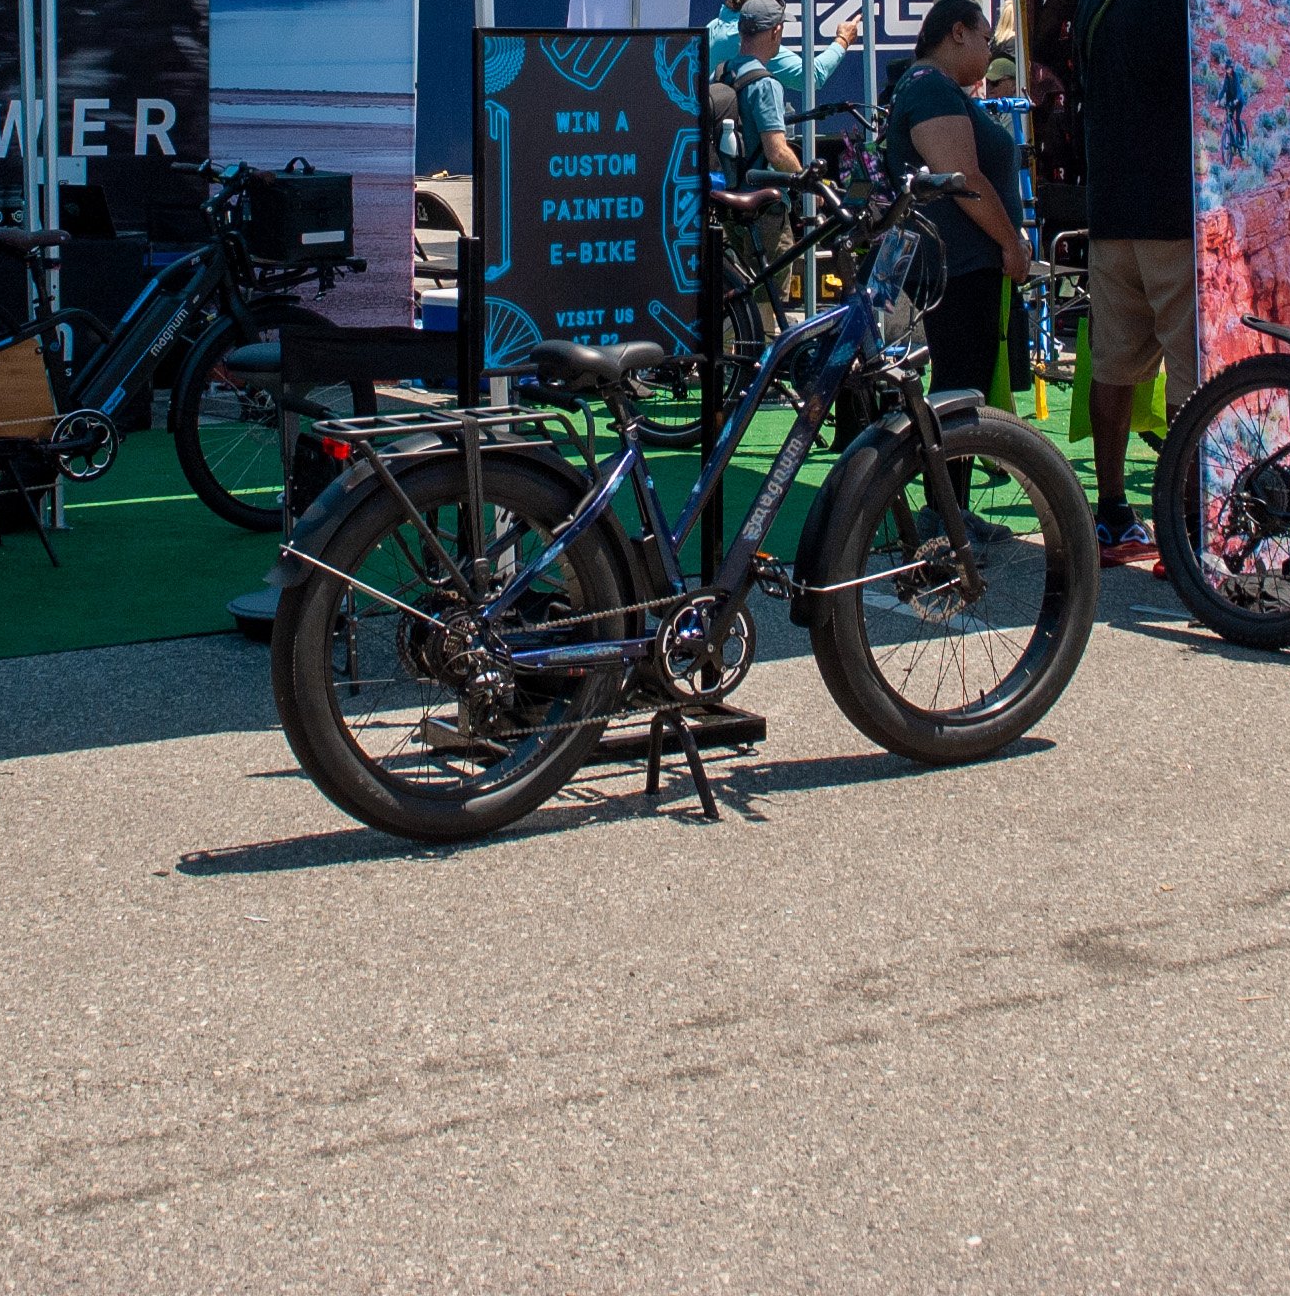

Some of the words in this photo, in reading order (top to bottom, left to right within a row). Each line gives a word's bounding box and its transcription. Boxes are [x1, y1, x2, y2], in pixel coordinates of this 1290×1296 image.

[556, 111, 600, 133] WIN
[615, 111, 629, 132] A
[549, 154, 637, 177] CUSTOM
[542, 196, 644, 222] PAINTED
[550, 240, 636, 265] E-BIKE
[556, 309, 604, 328] VISIT
[615, 308, 635, 324] US
[150, 307, 188, 357] magnum
